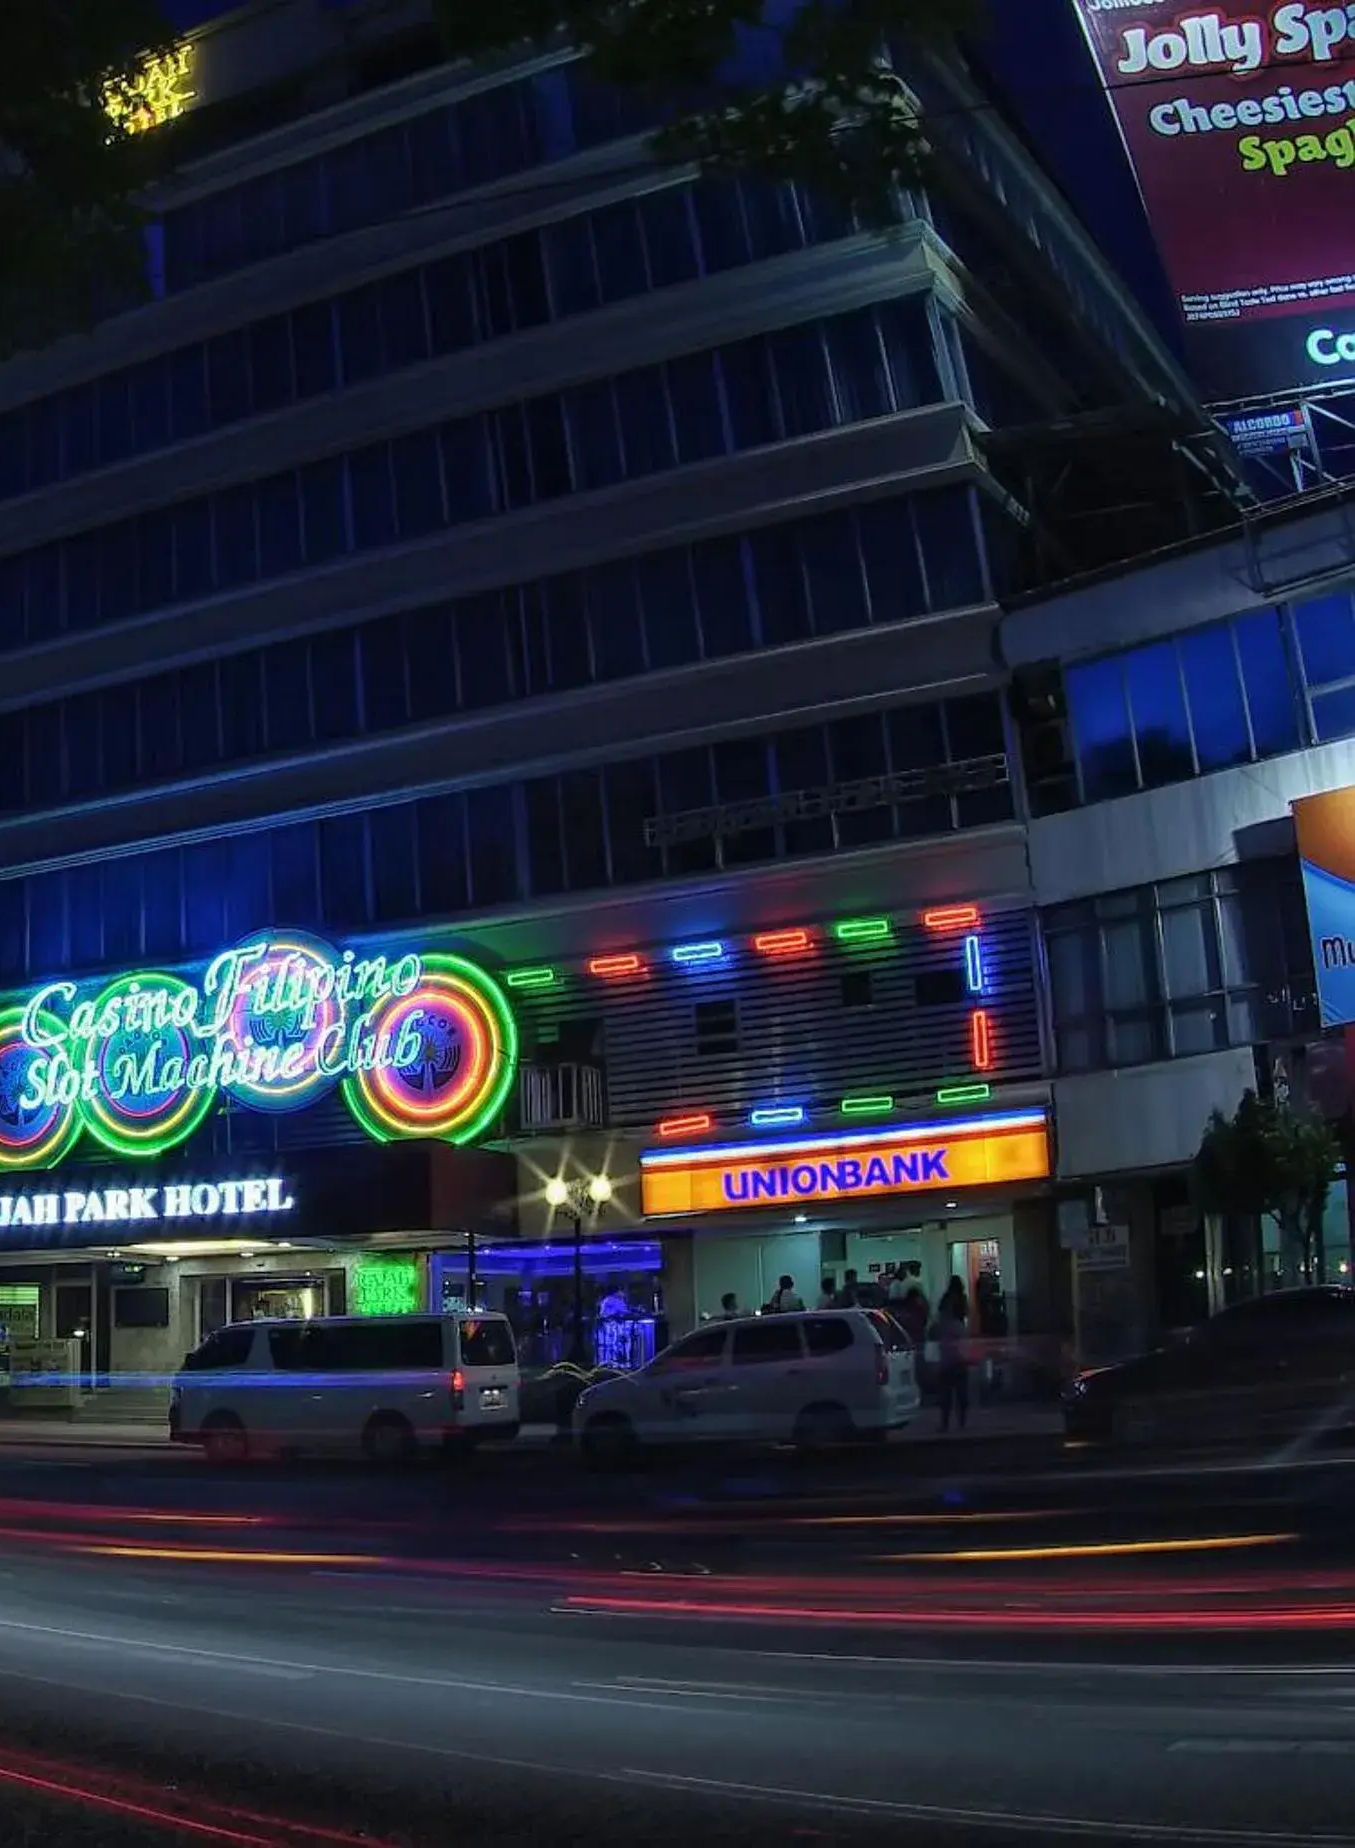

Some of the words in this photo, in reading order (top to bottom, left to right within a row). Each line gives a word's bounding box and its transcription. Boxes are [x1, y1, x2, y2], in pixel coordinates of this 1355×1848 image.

[1117, 11, 1262, 74] Jolly
[1150, 80, 1355, 136] Cheesiest
[1239, 118, 1355, 176] Spag
[1306, 329, 1355, 365] Co
[21, 981, 197, 1047] Casino
[193, 942, 423, 1037] Filipino
[19, 1034, 100, 1110] Slot
[112, 1036, 307, 1100] Machine
[315, 1009, 426, 1077] Club
[65, 1186, 160, 1223] PARK
[164, 1178, 294, 1217] HOTEL
[723, 1148, 949, 1201] UNIONBANK
